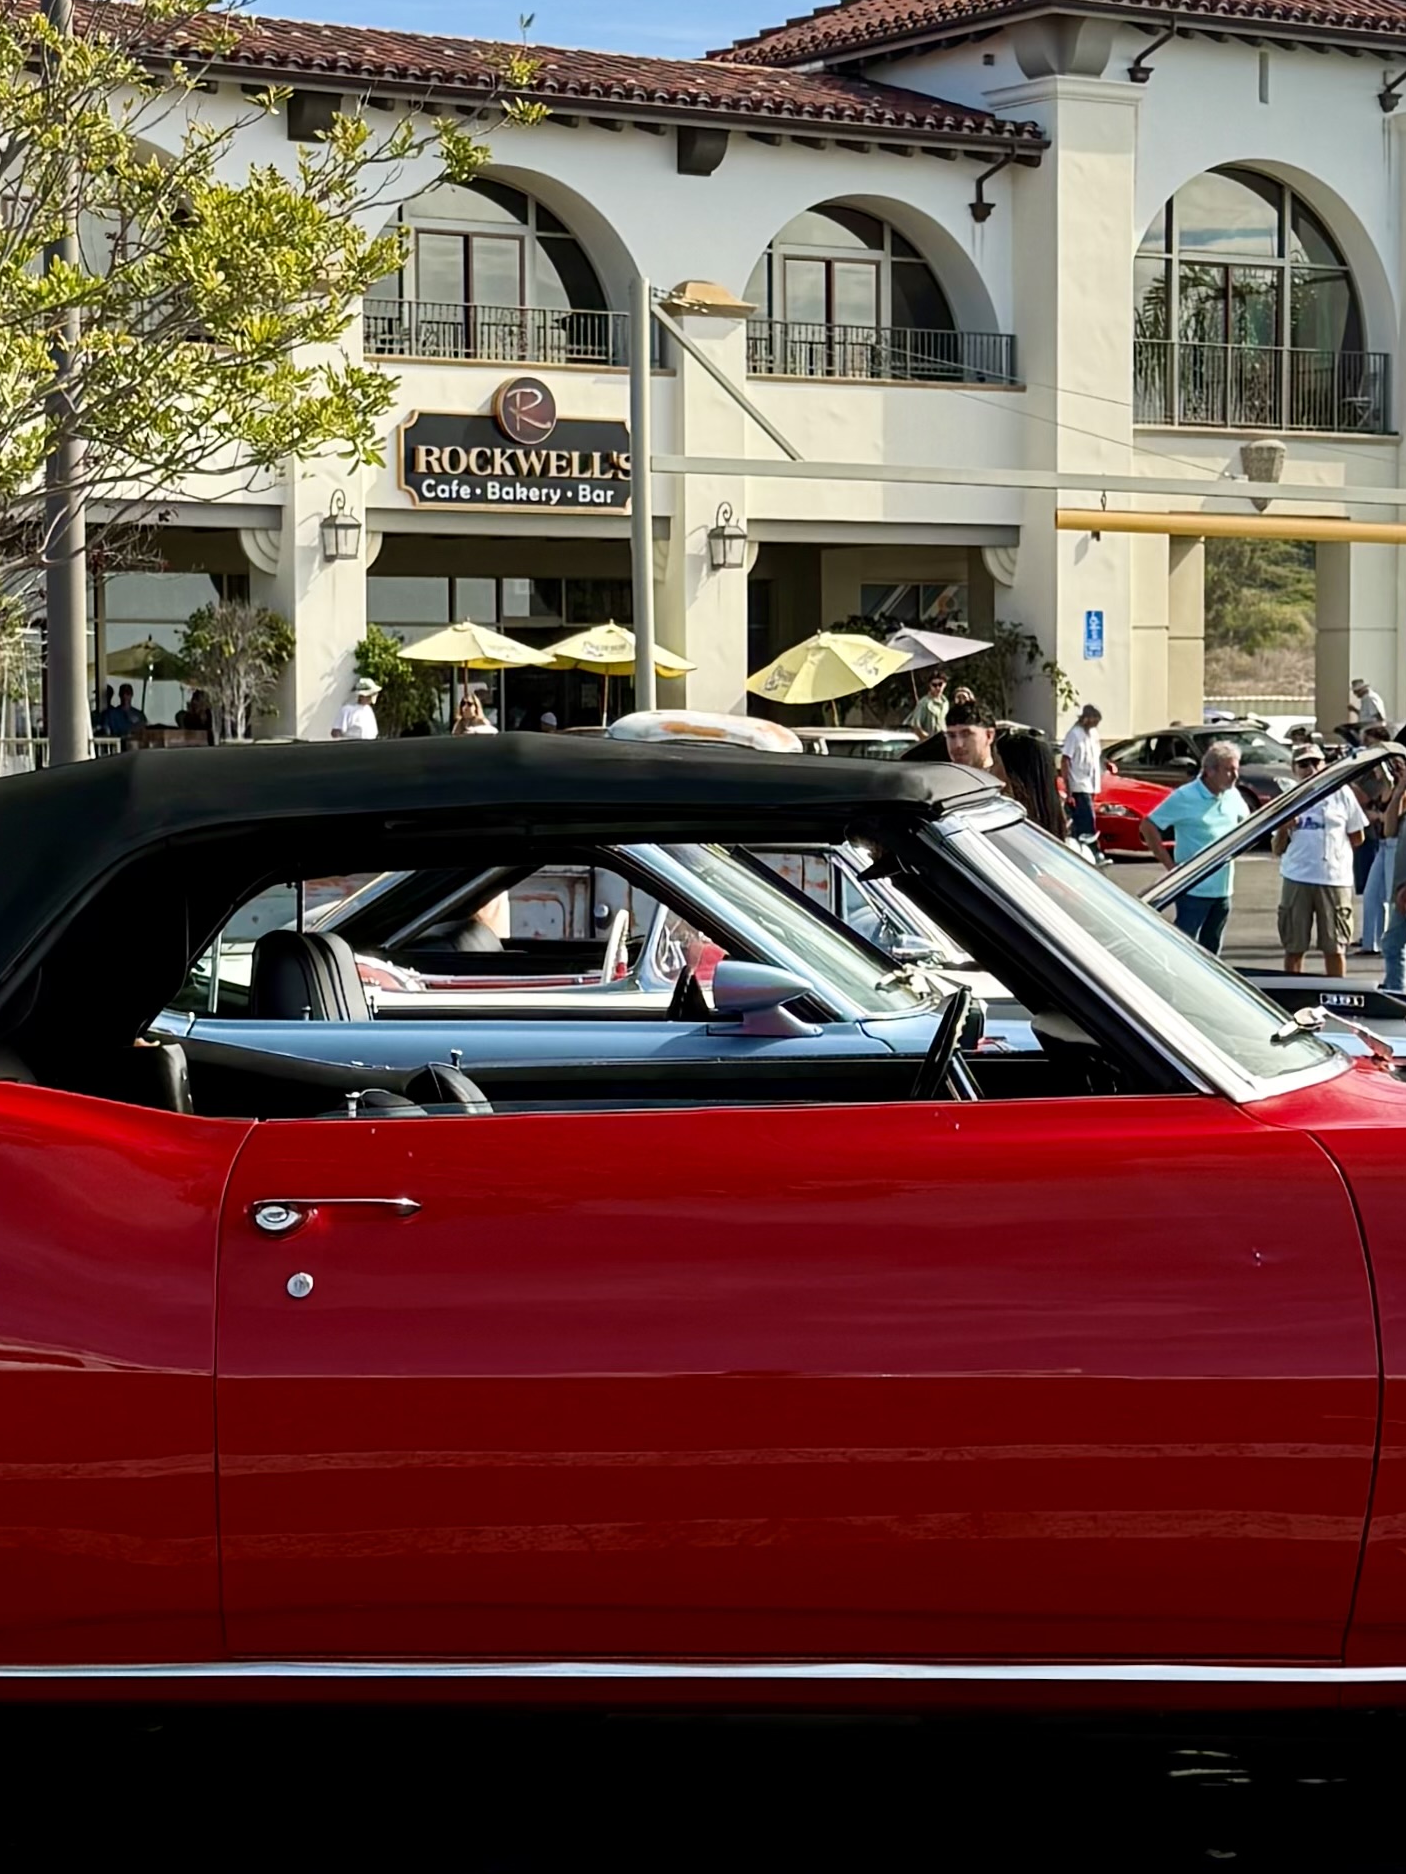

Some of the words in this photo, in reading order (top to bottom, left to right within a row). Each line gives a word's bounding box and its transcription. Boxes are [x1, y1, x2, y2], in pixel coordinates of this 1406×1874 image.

[506, 388, 552, 431] R
[415, 444, 631, 480] ROCKWELL'S
[421, 478, 471, 499] Cafe
[487, 481, 561, 505] Bakery
[577, 484, 614, 503] Bar
